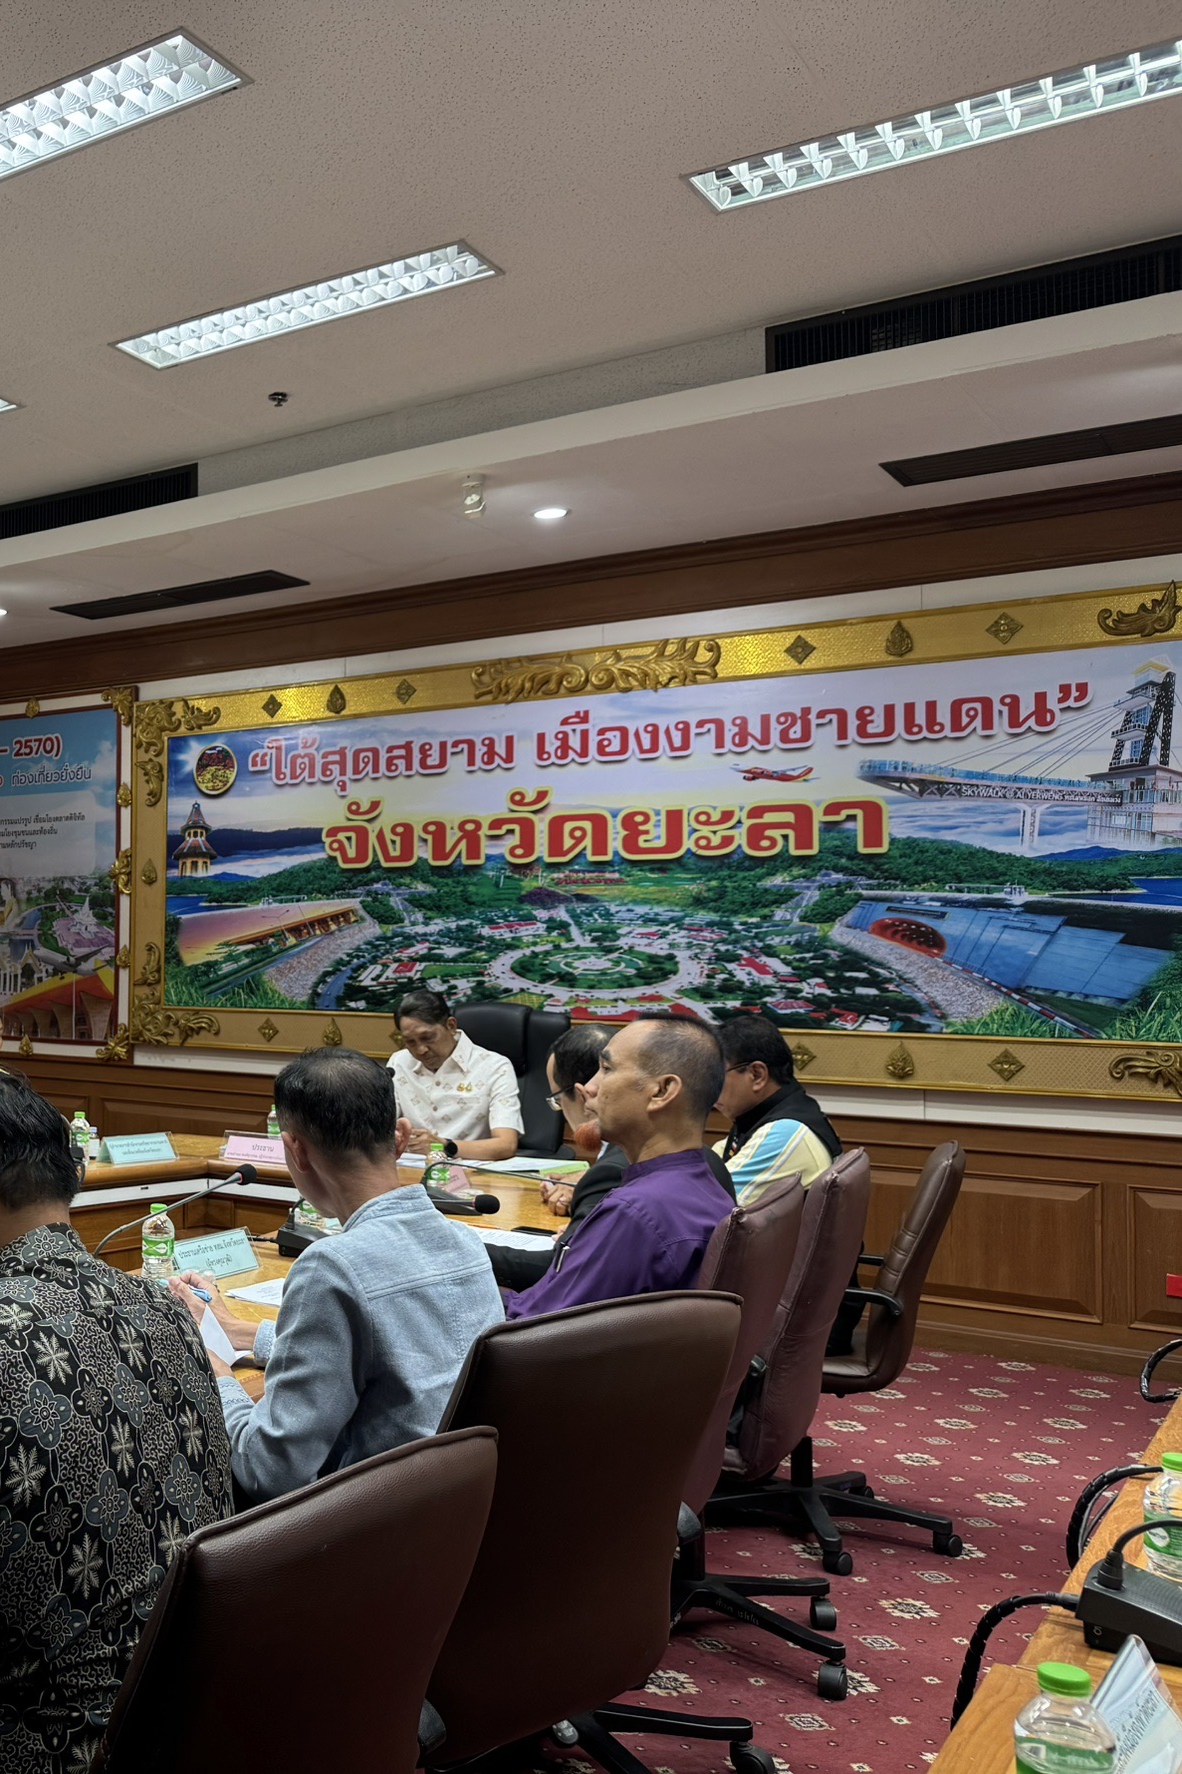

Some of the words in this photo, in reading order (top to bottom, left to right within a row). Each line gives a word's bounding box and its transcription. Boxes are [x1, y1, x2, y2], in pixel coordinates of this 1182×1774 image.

[535, 680, 1089, 763] เมืองงามชายแดน”
[13, 735, 62, 759] 2570)
[12, 762, 92, 785] ท่องเที่ยวยั่งยืน
[961, 787, 1005, 798] SKYWALK
[1027, 791, 1063, 802] YERWENG
[324, 788, 886, 867] จังหวัดยะลา
